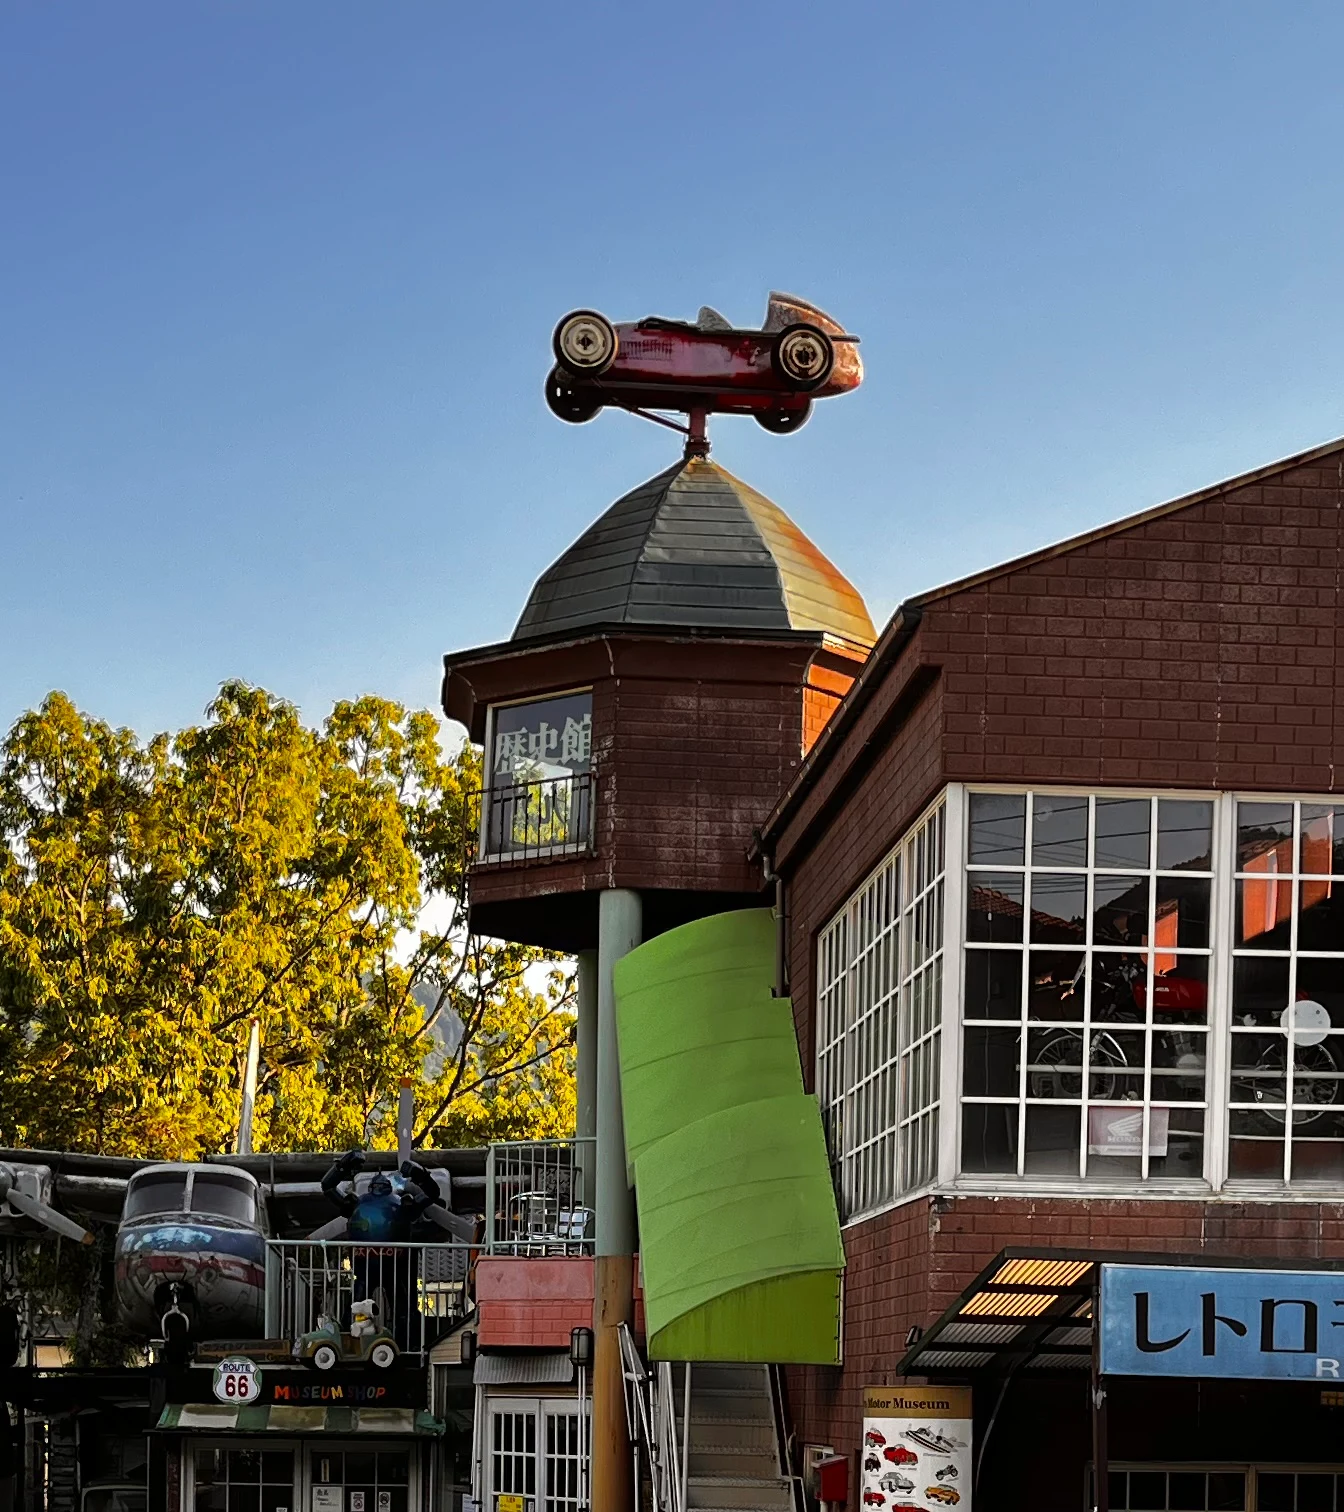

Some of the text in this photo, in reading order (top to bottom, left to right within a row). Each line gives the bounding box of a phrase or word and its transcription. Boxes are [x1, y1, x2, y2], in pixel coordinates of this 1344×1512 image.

[494, 714, 592, 776] 歴史館
[1107, 1135, 1143, 1143] HOND
[222, 1363, 251, 1372] ROUTE
[225, 1374, 249, 1397] 66
[274, 1385, 386, 1400] MUSEUM SHOP
[868, 1398, 891, 1409] Motor
[893, 1397, 950, 1410] Museum
